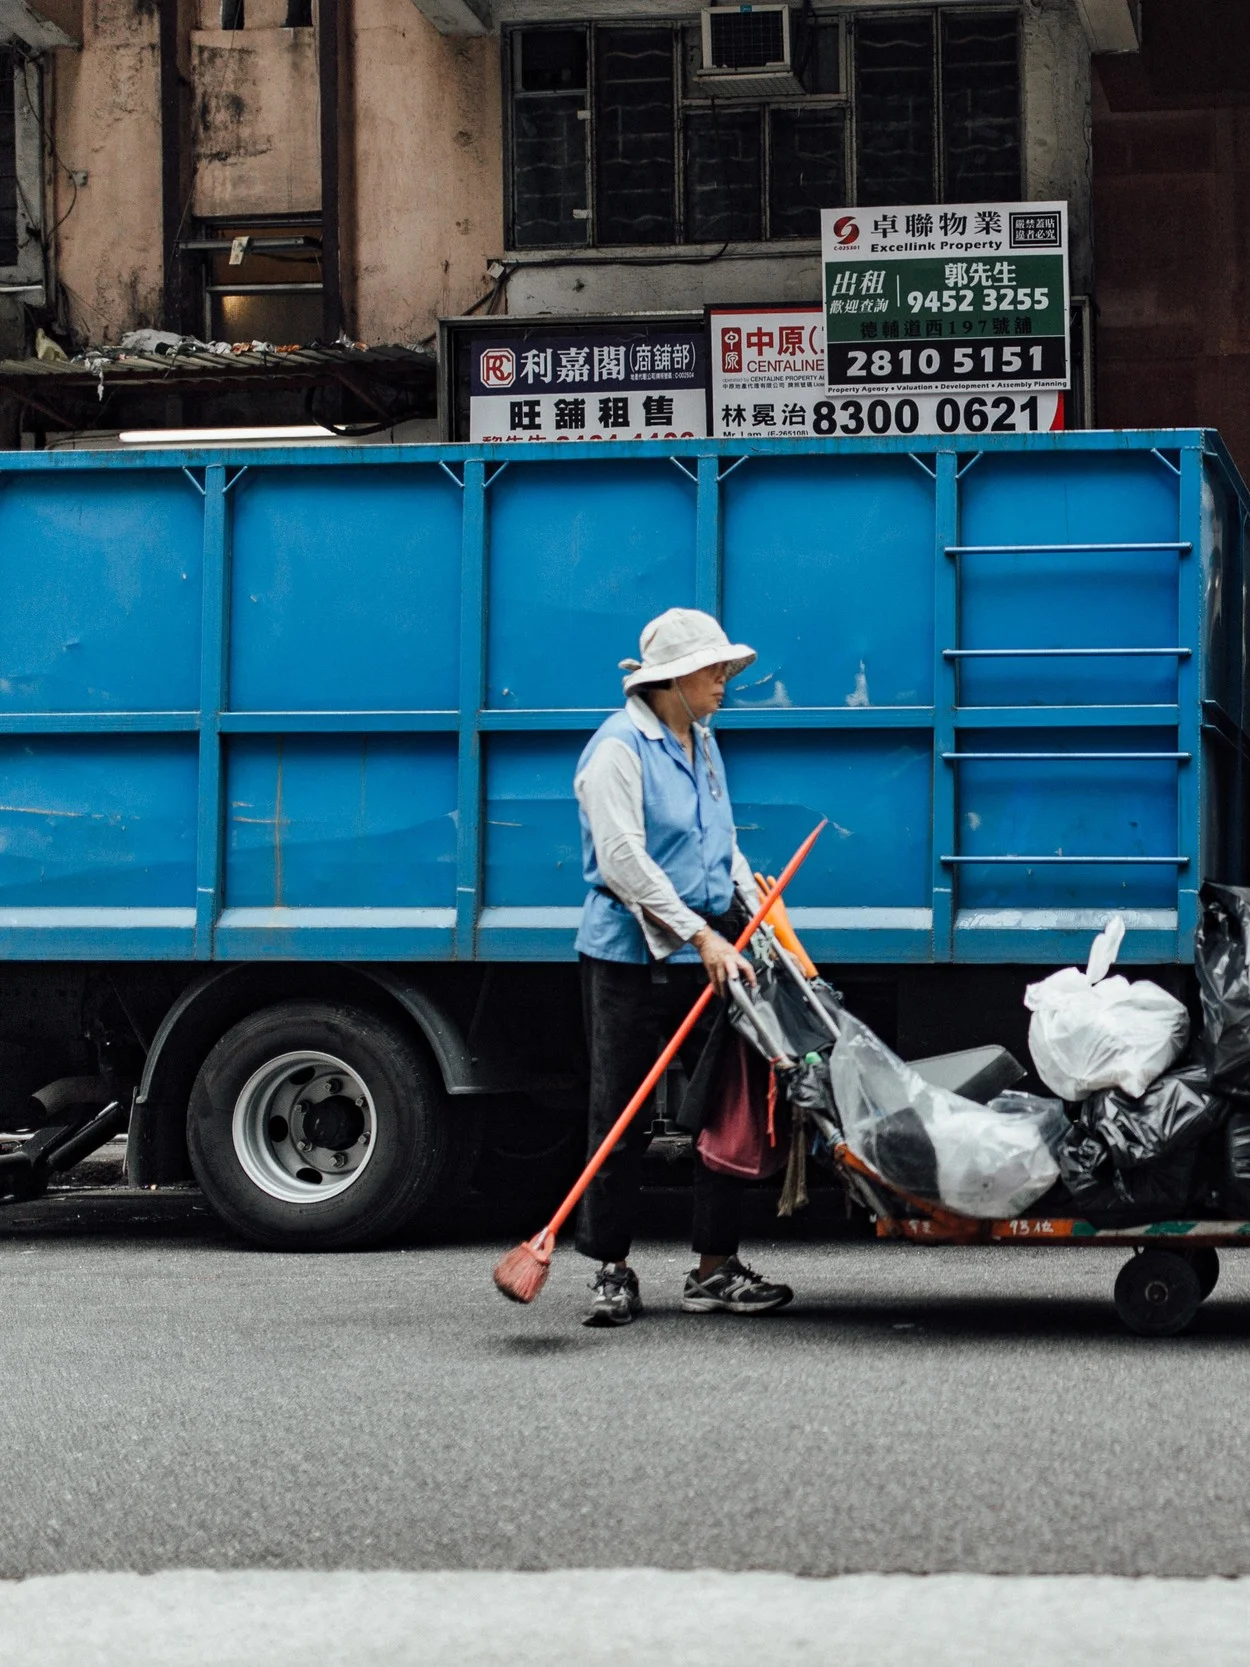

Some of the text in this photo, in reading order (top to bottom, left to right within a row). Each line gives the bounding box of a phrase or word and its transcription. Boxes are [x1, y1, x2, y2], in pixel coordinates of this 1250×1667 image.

[870, 210, 1002, 239] 卓聯物業
[871, 240, 1002, 253] Excellink Property
[831, 269, 887, 297] 出租
[944, 261, 1017, 288] 郭先生
[907, 288, 1049, 314] 9452 3255
[746, 325, 825, 357] 中原(
[520, 345, 627, 384] 利嘉閣
[747, 359, 825, 373] CENTALINE
[846, 345, 1043, 377] 2810 5151
[828, 380, 1068, 394] Property Agency Valuation Development Assembly Planning
[509, 395, 674, 431] 旺舖租售
[812, 398, 919, 435] 8300
[936, 395, 1039, 434] 0621
